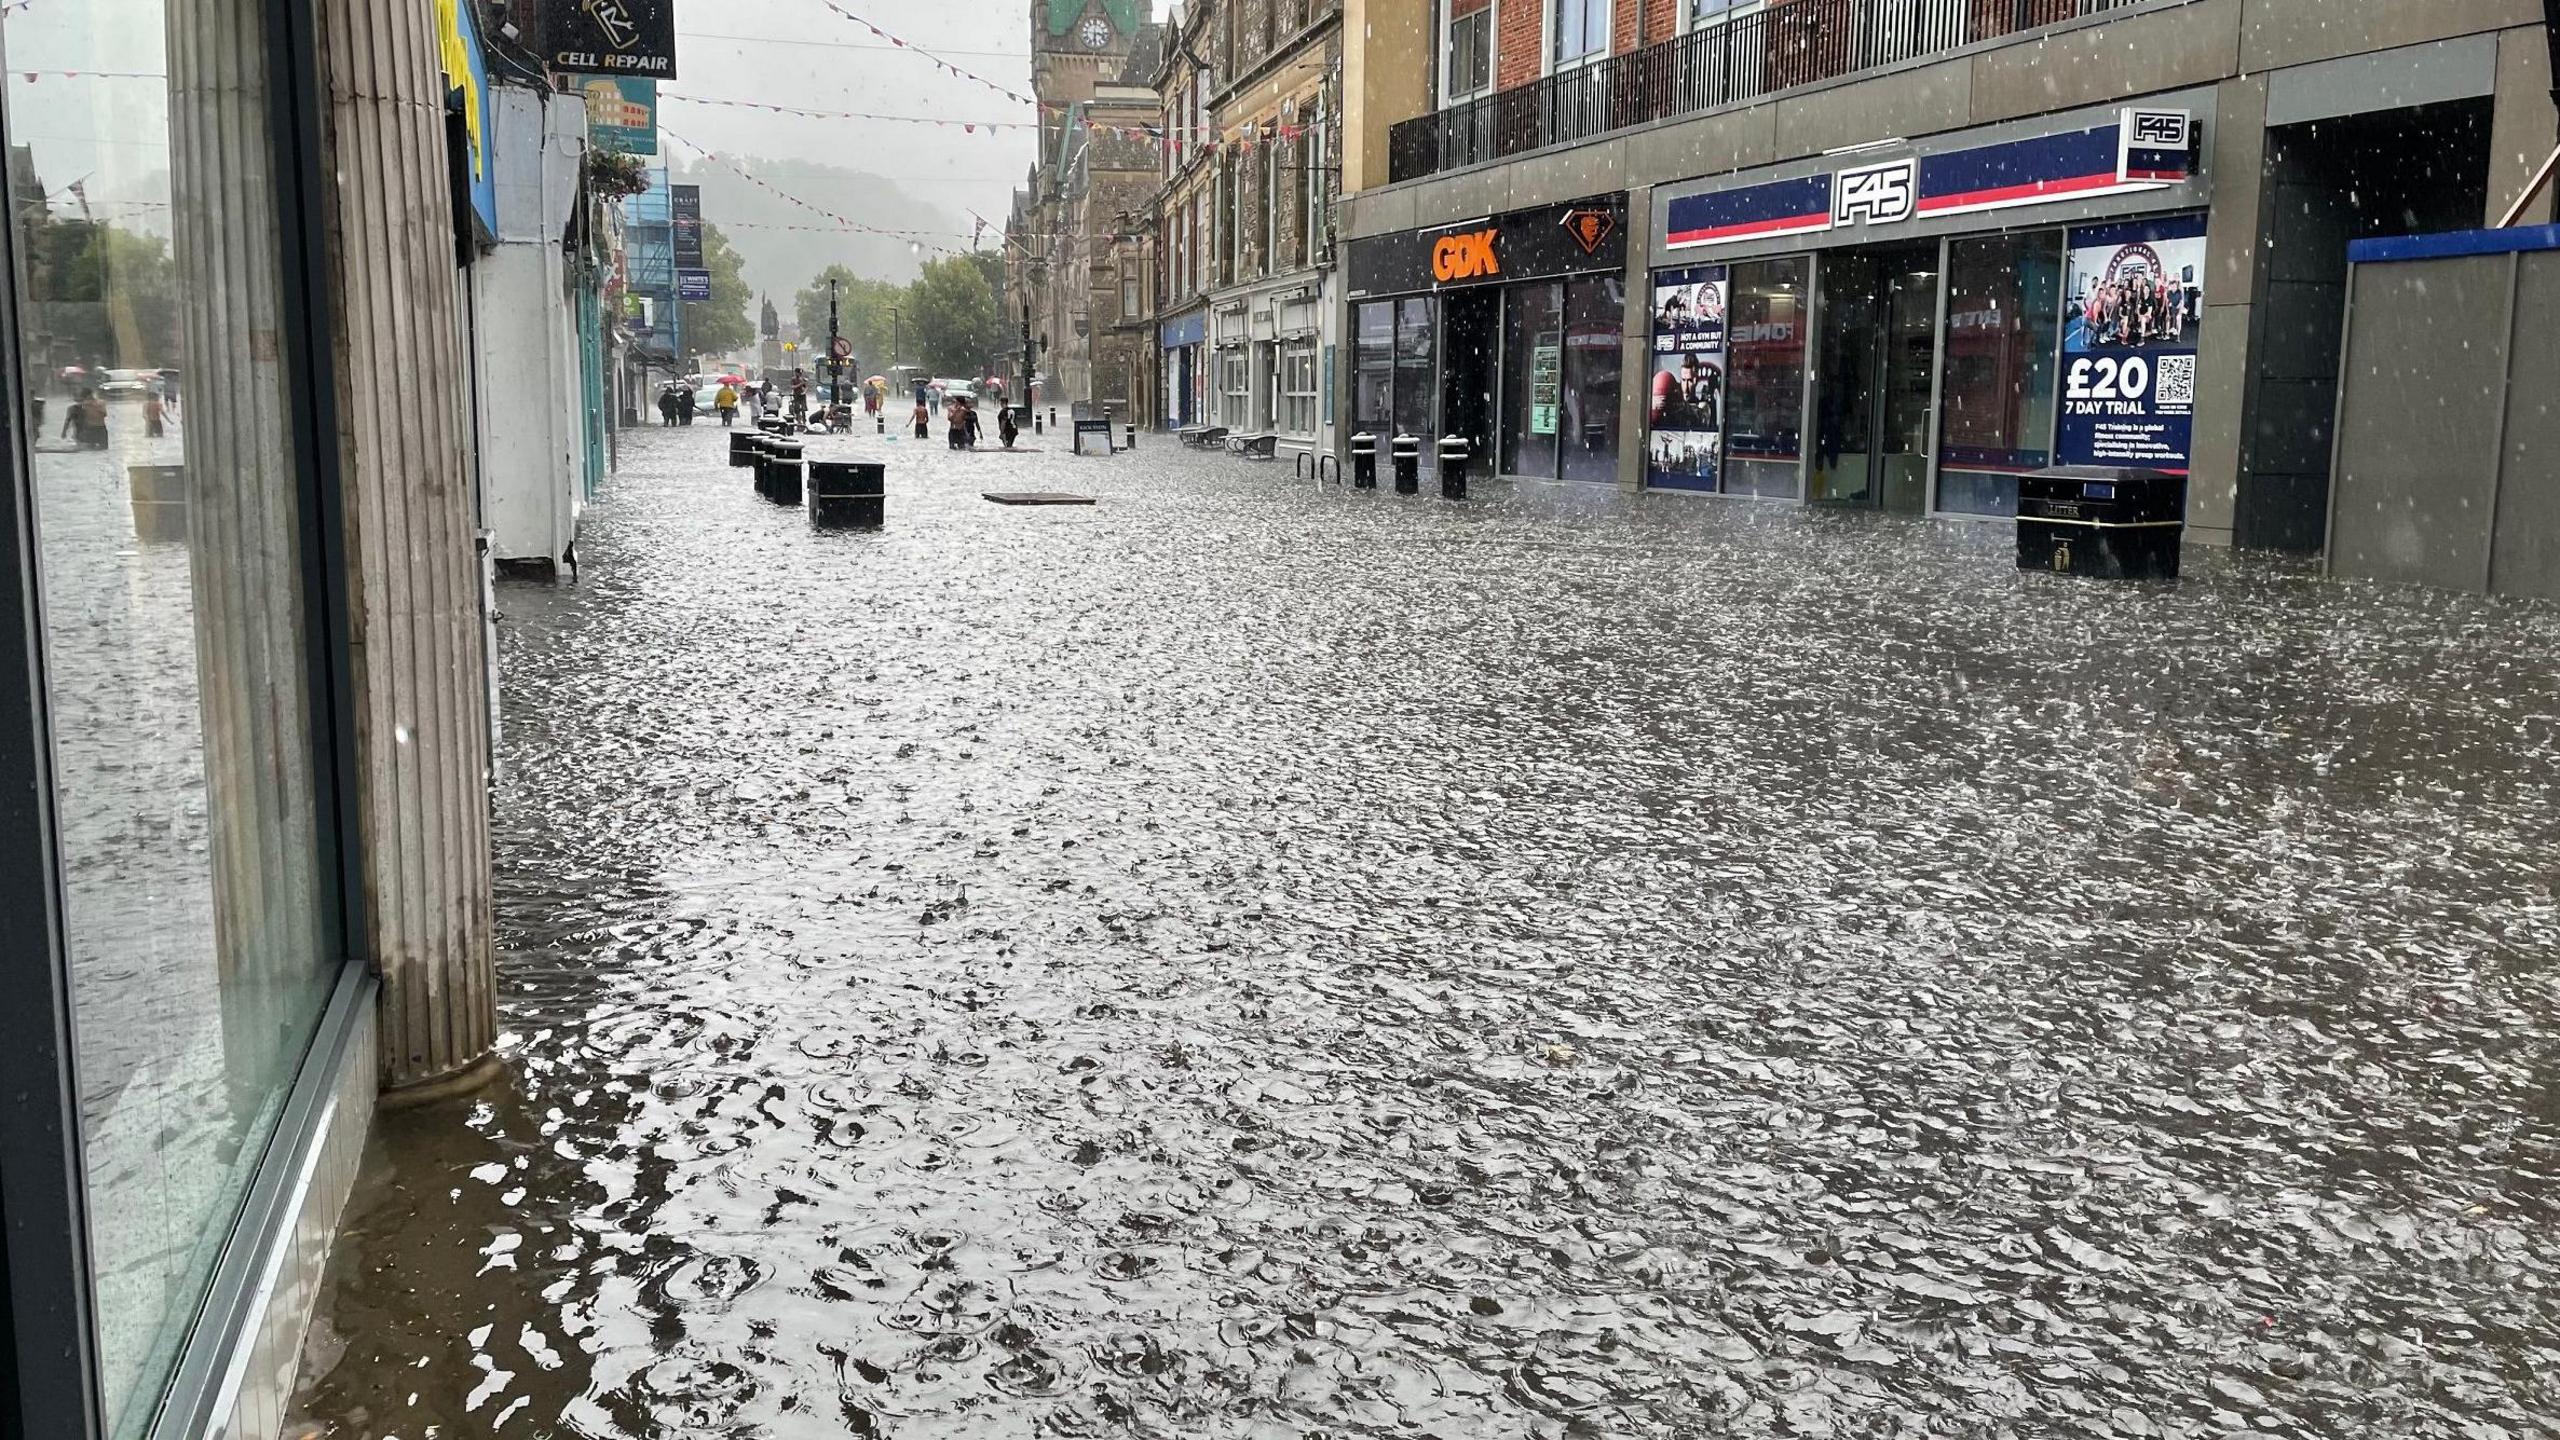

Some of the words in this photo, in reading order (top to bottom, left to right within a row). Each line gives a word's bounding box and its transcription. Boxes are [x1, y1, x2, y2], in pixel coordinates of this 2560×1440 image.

[557, 52, 599, 67] CELL
[604, 54, 668, 70] REPAIR
[2133, 112, 2186, 143] F45
[1837, 161, 1913, 224] F45
[1432, 228, 1500, 282] GDK
[1680, 333, 1692, 341] NOT
[1692, 333, 1697, 341] A
[1697, 332, 1710, 341] GYM
[1710, 331, 1722, 340] BUT
[1680, 342, 1685, 350] A
[1686, 341, 1719, 350] COMMUNITY
[2066, 356, 2149, 399] £20
[2065, 401, 2074, 415] 7
[2075, 401, 2103, 415] DAY
[2105, 401, 2146, 415] TRIAL
[2095, 423, 2107, 431] F45
[2108, 423, 2132, 432] Training
[2144, 424, 2165, 432] global
[2049, 504, 2080, 516] LITTER
